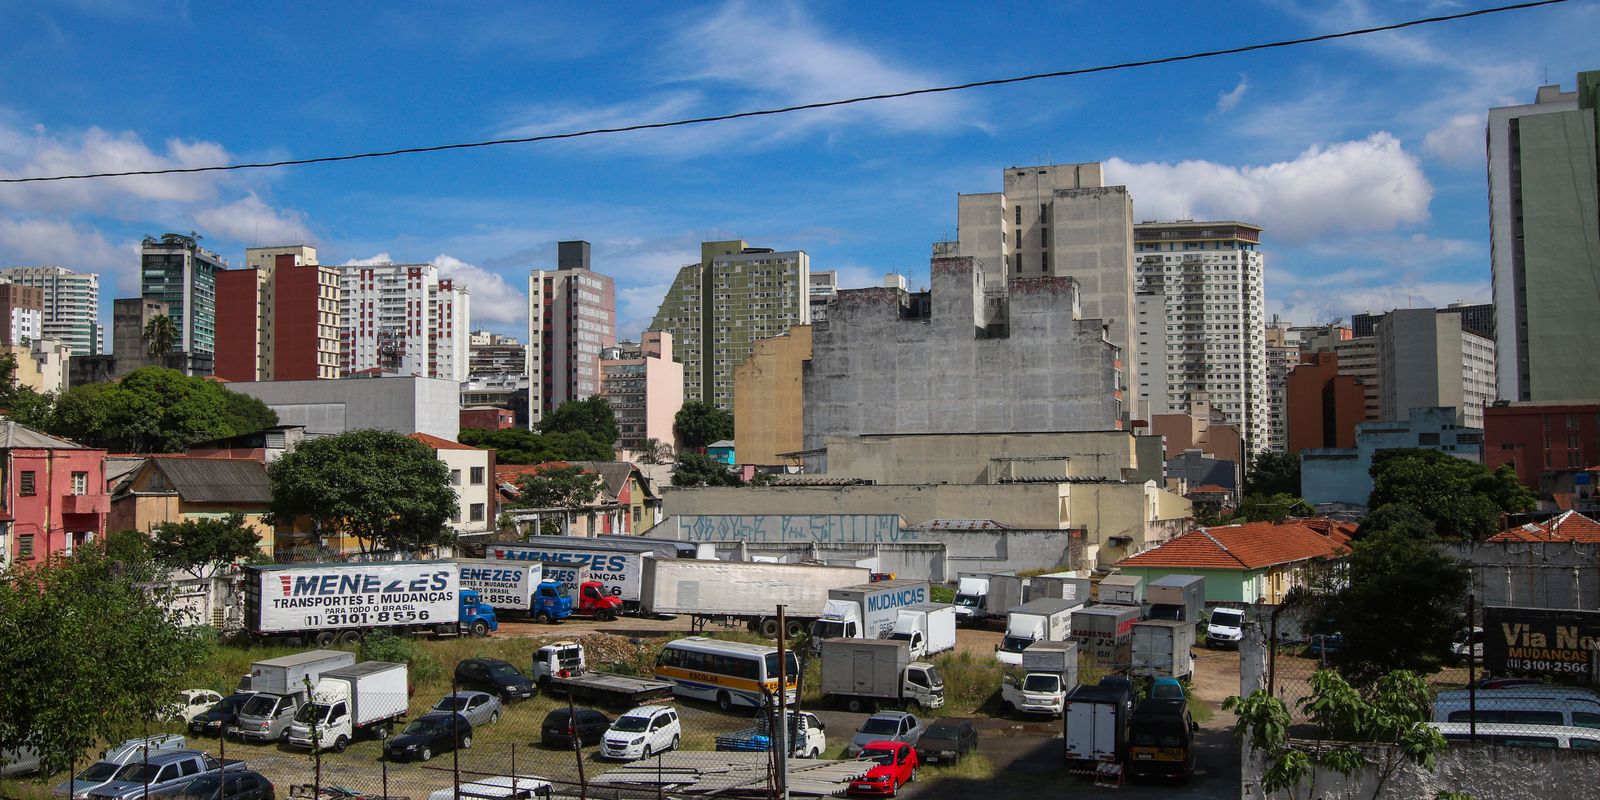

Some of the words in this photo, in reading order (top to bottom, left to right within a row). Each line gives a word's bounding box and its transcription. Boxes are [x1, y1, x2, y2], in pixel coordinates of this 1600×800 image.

[460, 568, 522, 582] ENEZES
[541, 569, 576, 582] EZES
[589, 573, 626, 582] ANÇAS
[293, 571, 450, 597] MENEZES
[273, 595, 363, 609] TRANSPORTES
[367, 594, 375, 605] E
[380, 592, 453, 604] MUDANÇAS
[382, 604, 416, 612] BRASIL
[304, 614, 323, 626] (11)
[1501, 622, 1547, 648] Via
[1556, 625, 1600, 650] No
